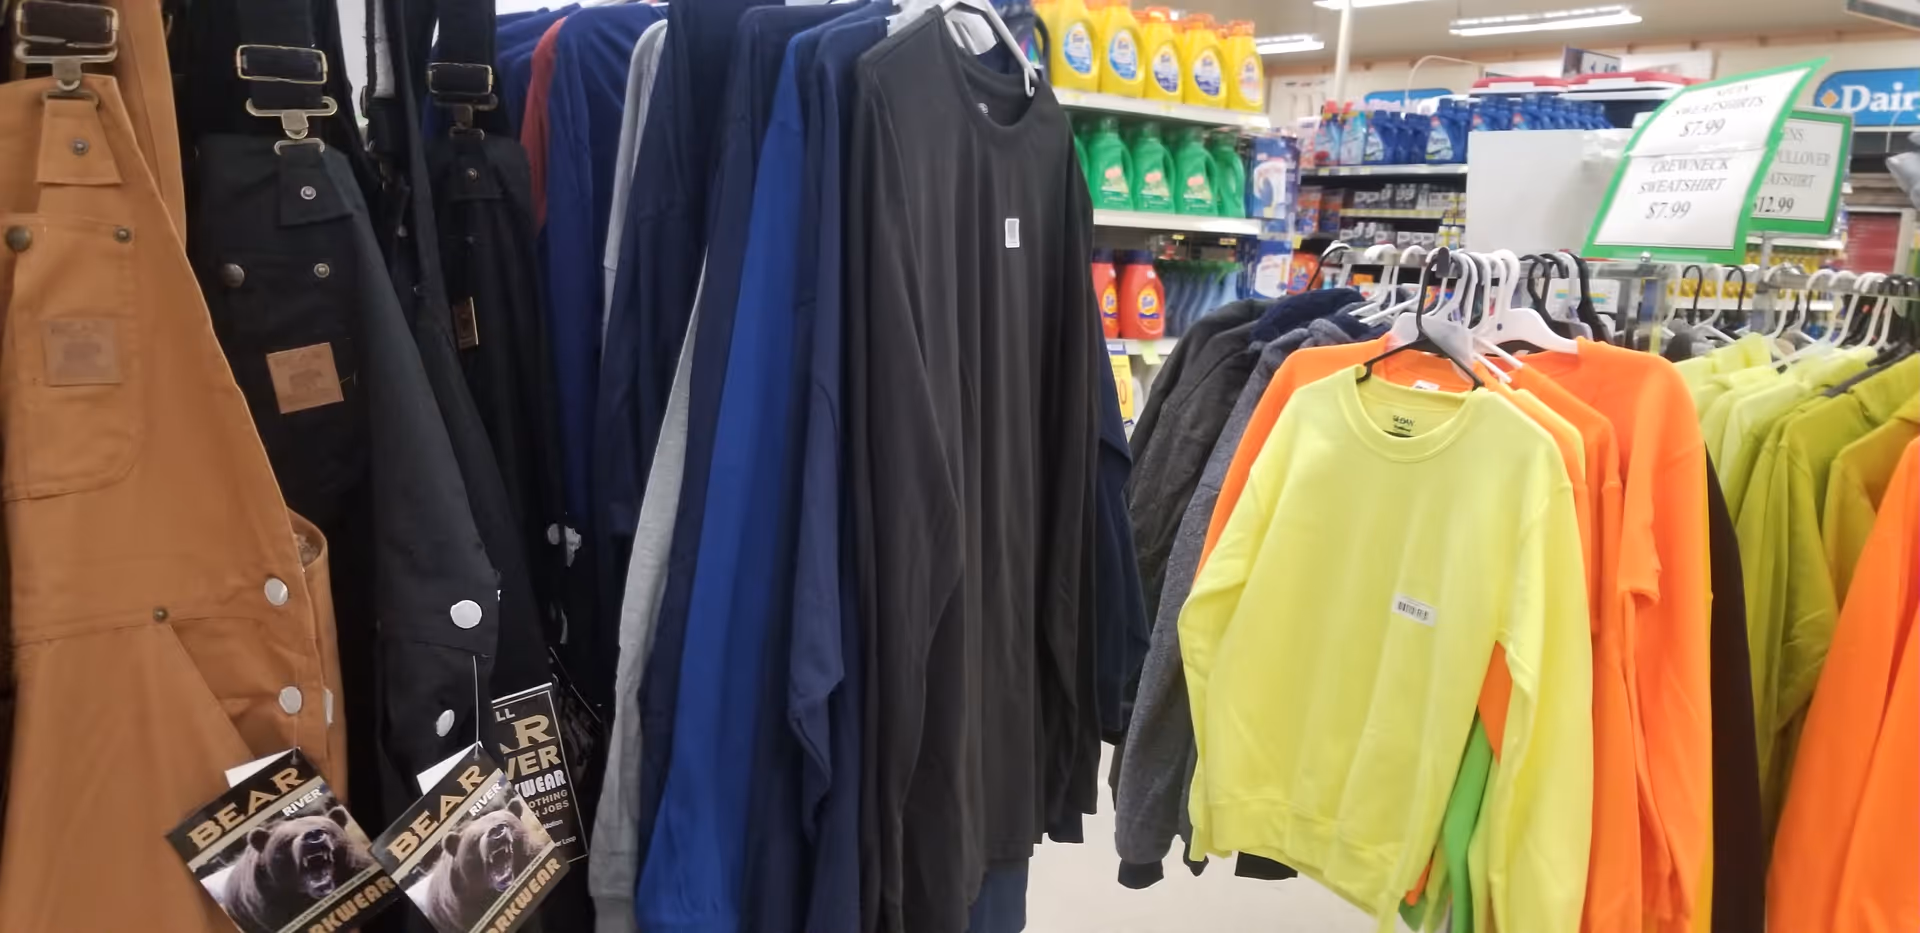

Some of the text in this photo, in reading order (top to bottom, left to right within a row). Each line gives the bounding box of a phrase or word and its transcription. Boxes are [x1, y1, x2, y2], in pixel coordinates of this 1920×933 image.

[1841, 82, 1920, 120] Dair
[1679, 118, 1726, 137] $7.99
[1651, 158, 1729, 173] CREWNECK
[1638, 178, 1727, 194] SWEATSHIRT
[1645, 201, 1692, 219] $7.99
[187, 767, 305, 850] BEAR
[281, 786, 324, 817] RIVER
[470, 780, 501, 817] RIVER
[541, 799, 570, 815] JOBS
[386, 765, 487, 862] BEAR
